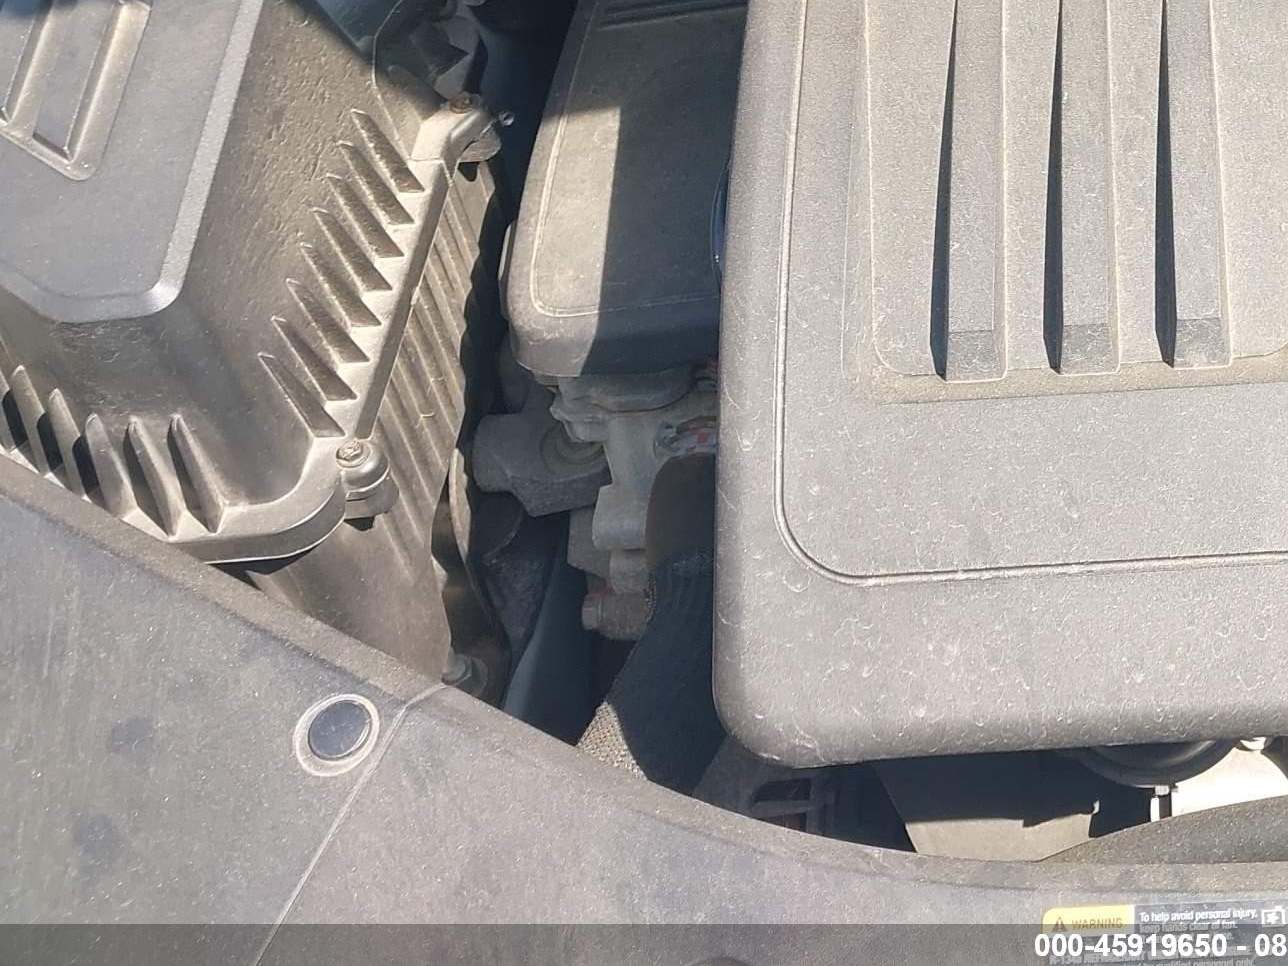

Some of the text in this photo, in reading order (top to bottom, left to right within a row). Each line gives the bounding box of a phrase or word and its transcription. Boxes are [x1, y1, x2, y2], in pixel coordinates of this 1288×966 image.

[1139, 912, 1150, 923] To
[1151, 911, 1170, 923] help
[1171, 909, 1194, 921] avoid
[1195, 908, 1231, 922] personal
[1072, 918, 1122, 931] WARNING
[1140, 923, 1160, 934] keep
[1162, 922, 1187, 933] hands
[1189, 921, 1210, 932] clear
[1211, 920, 1220, 930] of
